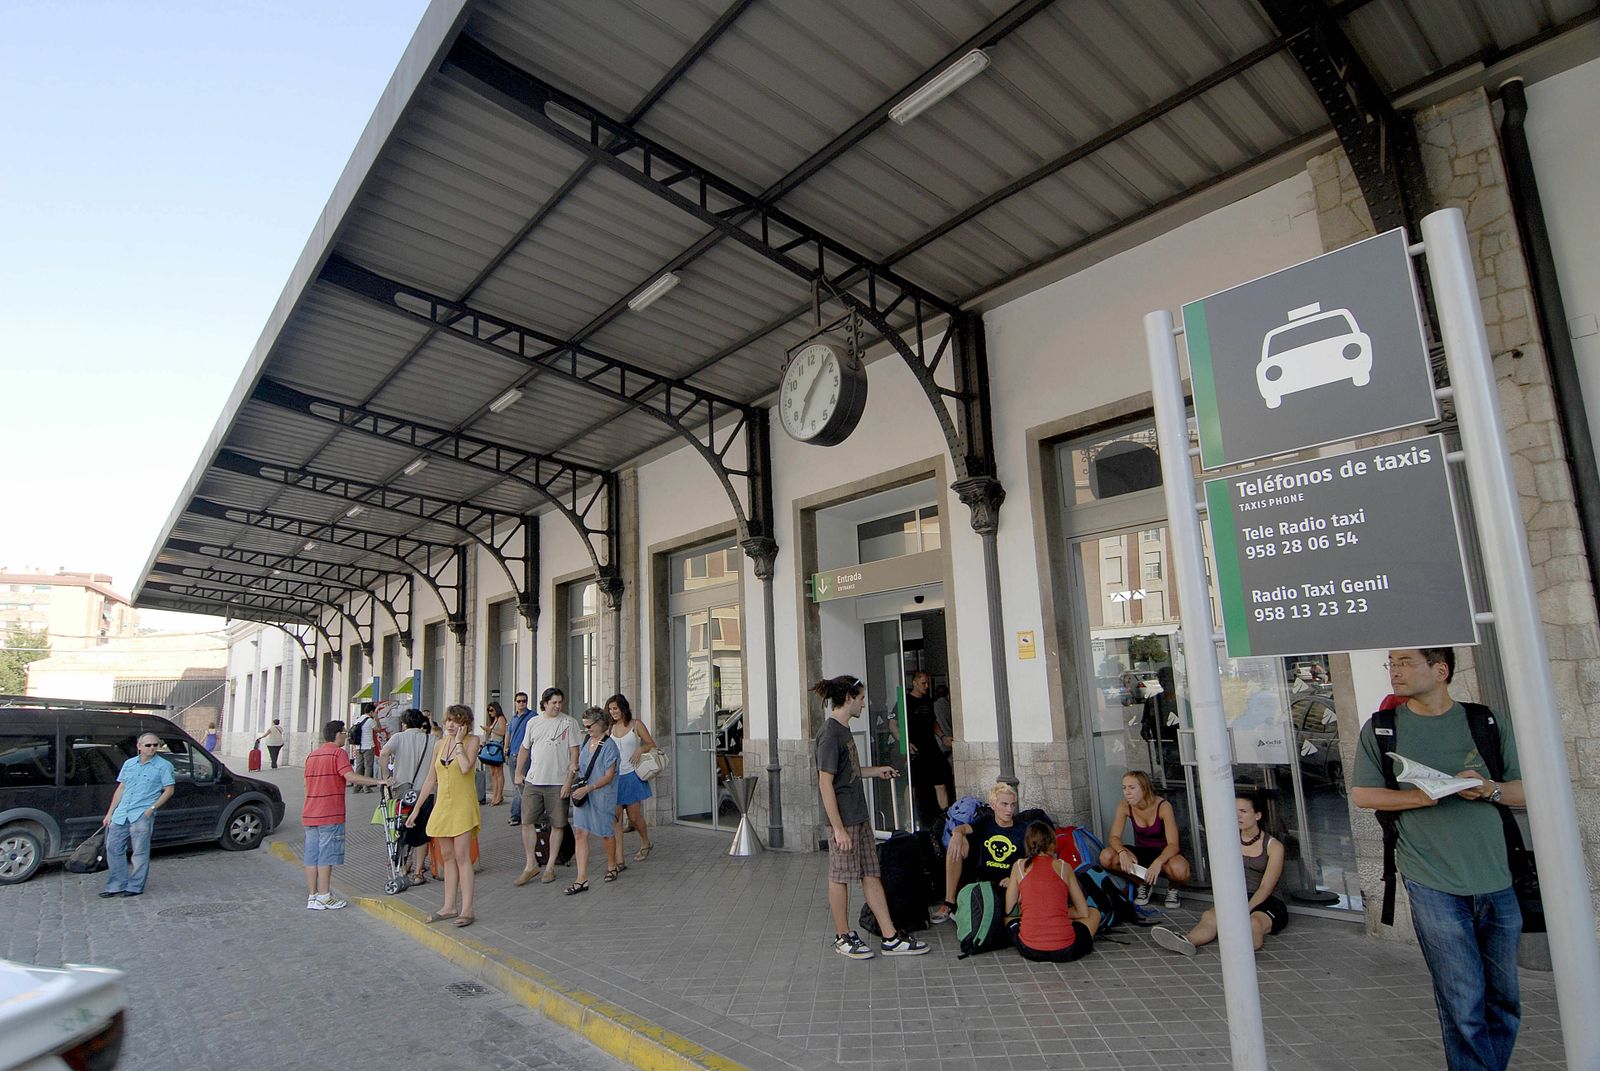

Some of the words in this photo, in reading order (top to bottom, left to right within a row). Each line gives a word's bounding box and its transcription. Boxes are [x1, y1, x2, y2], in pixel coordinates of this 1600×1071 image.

[807, 355, 815, 367] 12
[798, 365, 804, 376] 11
[828, 362, 834, 373] 2
[789, 380, 798, 392] 10
[833, 376, 839, 387] 3
[787, 399, 793, 408] 9
[829, 394, 836, 405] 4
[793, 411, 799, 421] 8
[822, 410, 828, 421] 5
[811, 420, 816, 431] 6
[1235, 468, 1333, 498] Teléfonos
[1339, 460, 1367, 479] de
[1373, 446, 1432, 472] taxis
[1238, 499, 1267, 512] TAXIS
[1269, 492, 1305, 507] PHONE
[1242, 525, 1274, 541] Tele
[1278, 516, 1327, 536] Radio
[1330, 508, 1366, 527] taxi
[1245, 543, 1277, 560] 958
[1281, 539, 1303, 555] 28
[1307, 534, 1330, 551] 06
[1335, 531, 1359, 547] 54
[837, 572, 862, 584] Entrada
[1251, 586, 1298, 603] Radio
[1301, 580, 1336, 598] Taxi
[1340, 574, 1389, 594] Genil
[1254, 607, 1286, 622] 958
[1290, 603, 1312, 619] 13
[1317, 601, 1339, 617] 23
[1345, 598, 1368, 614] 23
